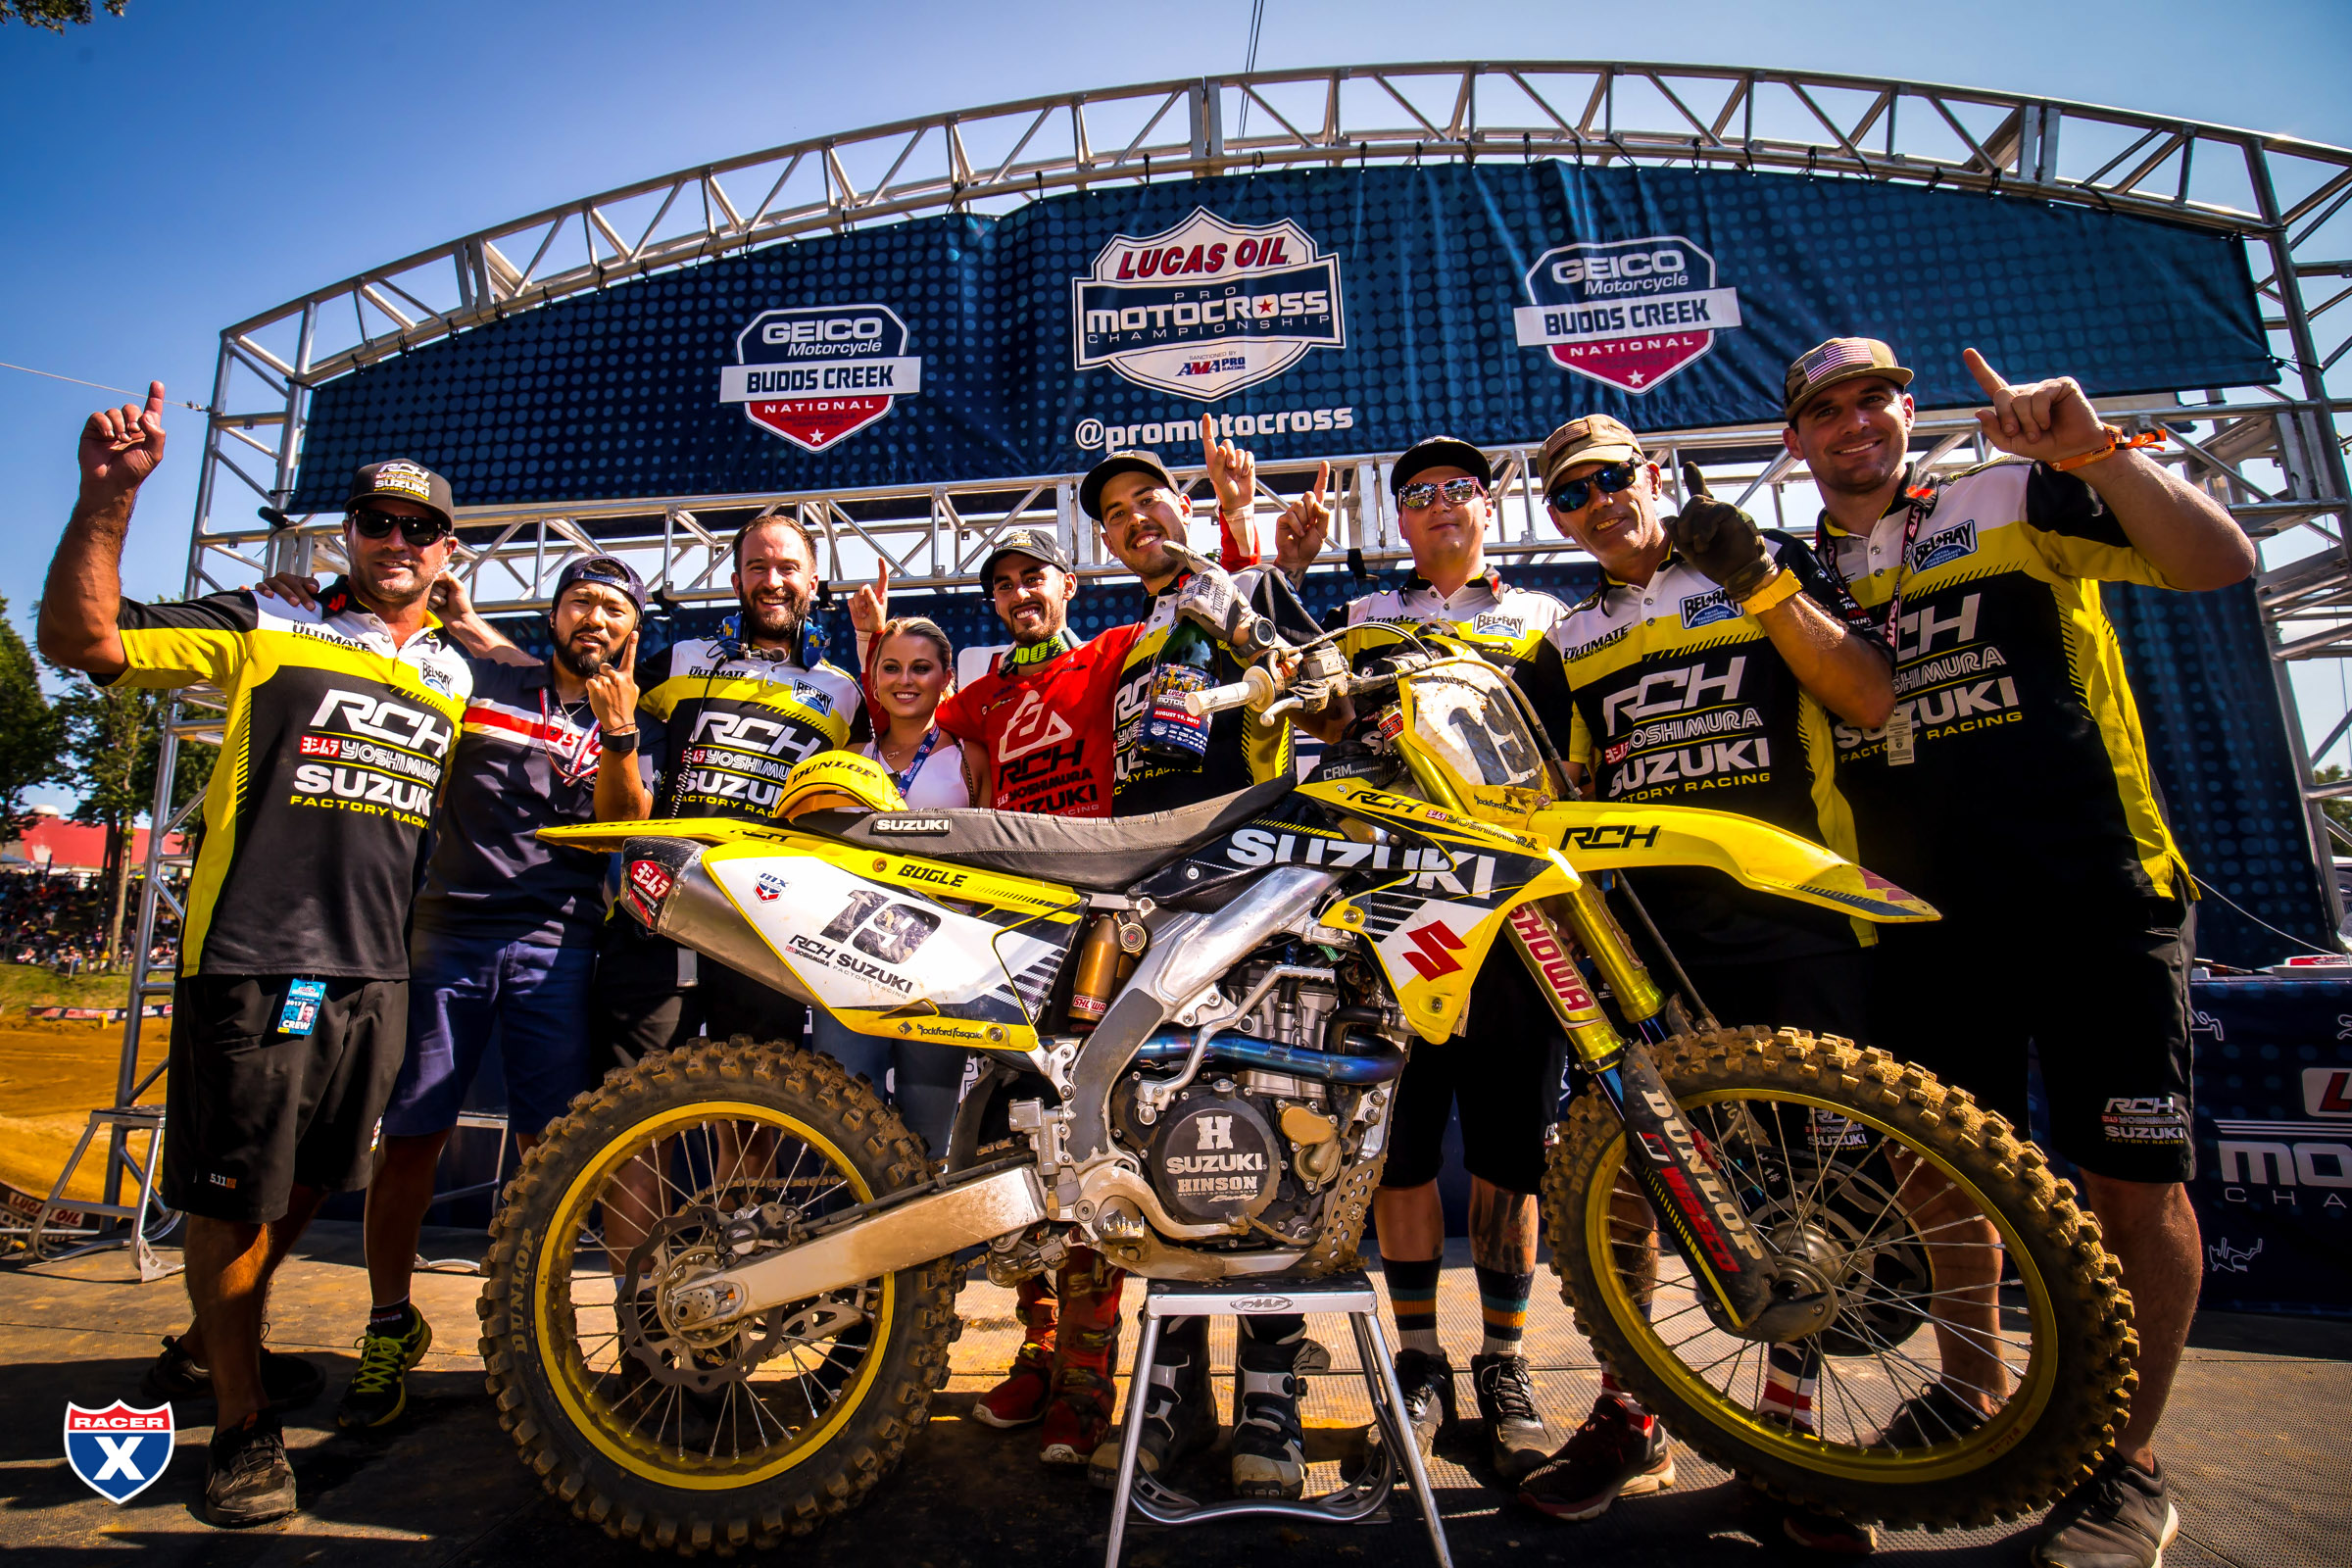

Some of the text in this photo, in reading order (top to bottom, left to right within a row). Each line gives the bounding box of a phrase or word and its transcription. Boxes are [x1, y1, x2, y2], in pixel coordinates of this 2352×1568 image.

[1116, 237, 1287, 280] LUCAS OIL
[1551, 250, 1685, 284] GEICO
[1175, 286, 1236, 301] PRO
[1585, 272, 1689, 295] Motorcycle
[1087, 290, 1329, 333] MOTOCROSS
[1544, 298, 1711, 336] BUDDS CREEK
[762, 318, 882, 344] GEICO
[1088, 315, 1330, 343] CHAMPIONSHIP
[787, 339, 882, 357] Motorcycle
[1189, 351, 1228, 361] SANCTIONED
[1570, 337, 1693, 357] NATIONAL
[747, 365, 894, 393] BUDDS CREEK
[1175, 357, 1246, 376] AMA PRO
[764, 400, 874, 414] NATIONAL
[374, 479, 429, 497] SUZUKI
[292, 624, 370, 653] ULTIMATE
[1564, 621, 1633, 661] ULTIMATE
[1895, 592, 1981, 662] CH
[689, 668, 748, 678] ULTIMATE
[1893, 646, 2007, 695] SHIMURA
[1157, 697, 1186, 706] MOTOC
[1168, 689, 1186, 699] LUCAS
[1603, 656, 1746, 737] RCH
[310, 689, 453, 758] RCH
[694, 711, 821, 763] RCH
[1448, 686, 1540, 785] 19
[1629, 708, 1764, 750] OSHIMURA
[1927, 711, 2023, 740] RACING
[705, 749, 792, 780] YOSHIMU
[792, 760, 877, 785] DUNLOP
[999, 740, 1085, 790] RCH
[1608, 738, 1770, 798] SUZUKI
[294, 764, 433, 816] SUZUK
[685, 770, 783, 808] SUZU
[1008, 768, 1094, 802] YOSHIMURA
[1008, 783, 1098, 813] UZUKI
[1616, 772, 1771, 804] CTORY RACING
[290, 795, 390, 816] FACTORY
[745, 803, 774, 817] RAC
[1059, 805, 1099, 816] ACING
[1347, 790, 1423, 812] RCH
[877, 819, 949, 831] SUZUKI
[1446, 813, 1538, 851] YOSHIMURA
[1558, 824, 1661, 852] RCH
[1226, 829, 1496, 900] SUZUKI
[633, 862, 670, 898] ヨシムラ
[820, 889, 942, 964] 19
[789, 934, 912, 994] RCH SUZUKI
[1508, 902, 1594, 1011] SHOWA
[795, 949, 906, 1000] YOSHIMURA FACTORY RACING
[1074, 996, 1106, 1011] SHOWA
[282, 1020, 311, 1030] CREW
[2104, 1097, 2173, 1113] RCH
[1197, 1115, 1234, 1151] H
[1808, 1133, 1868, 1146] SUZUKI
[2104, 1126, 2183, 1139] SUZUKI
[1166, 1153, 1263, 1174] SUZUKI
[1642, 1090, 1763, 1260] DUNLOP
[1177, 1176, 1257, 1193] HINSON
[11, 1195, 56, 1218] LUCA
[55, 1208, 81, 1225] OIL
[510, 1228, 534, 1354] DUNLOP
[1238, 1298, 1286, 1308] FMF
